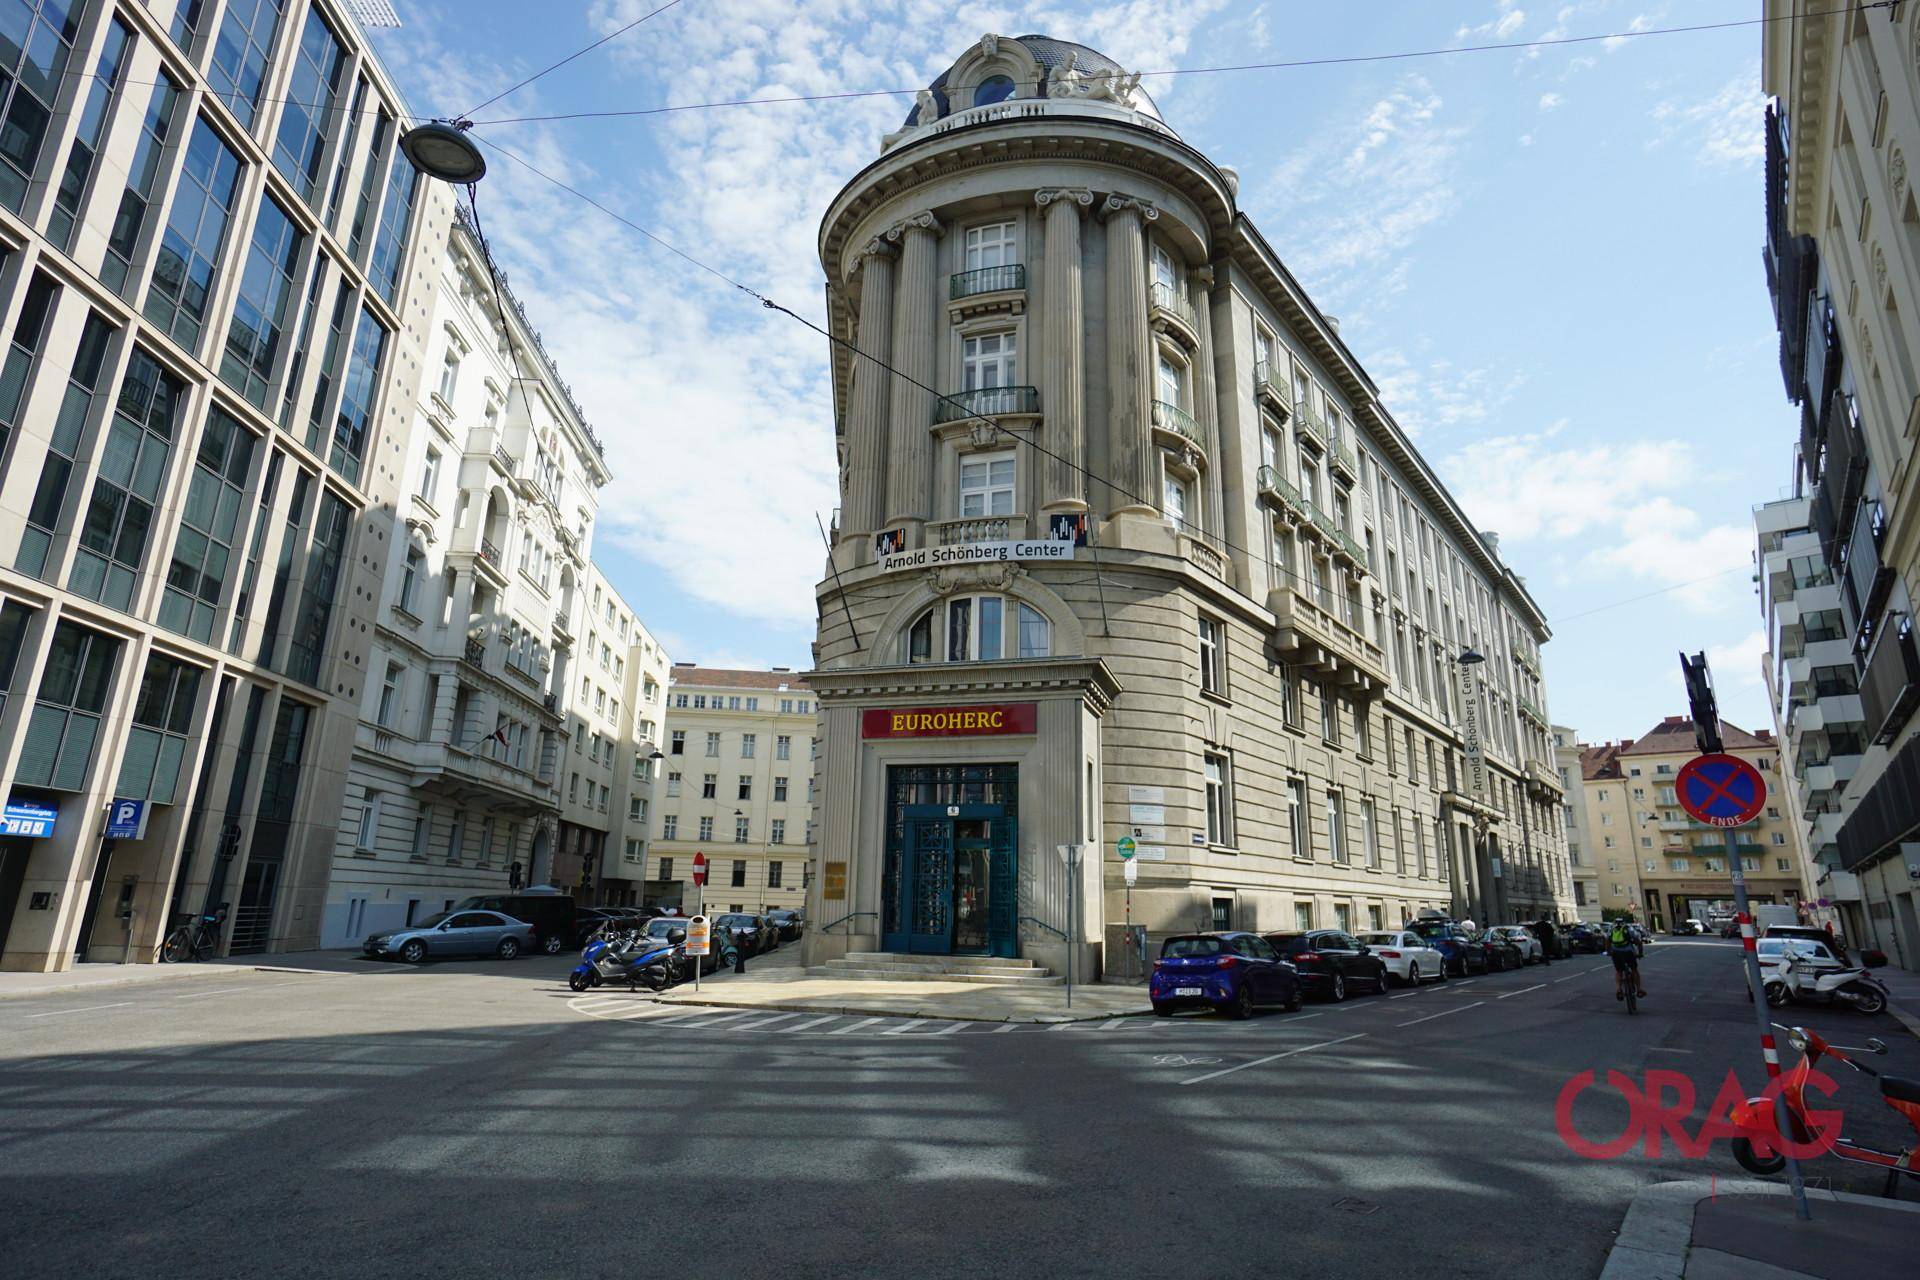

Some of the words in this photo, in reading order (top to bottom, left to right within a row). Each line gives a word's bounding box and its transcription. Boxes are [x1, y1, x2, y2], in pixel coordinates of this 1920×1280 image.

[884, 551, 926, 570] Arnold
[932, 545, 1008, 563] Schönberg
[1015, 543, 1065, 557] Center
[892, 711, 1004, 731] EUROHERC
[1465, 699, 1479, 753] Schönberg
[1470, 757, 1481, 791] Arnold
[116, 806, 135, 825] P
[1710, 815, 1743, 827] ENDE
